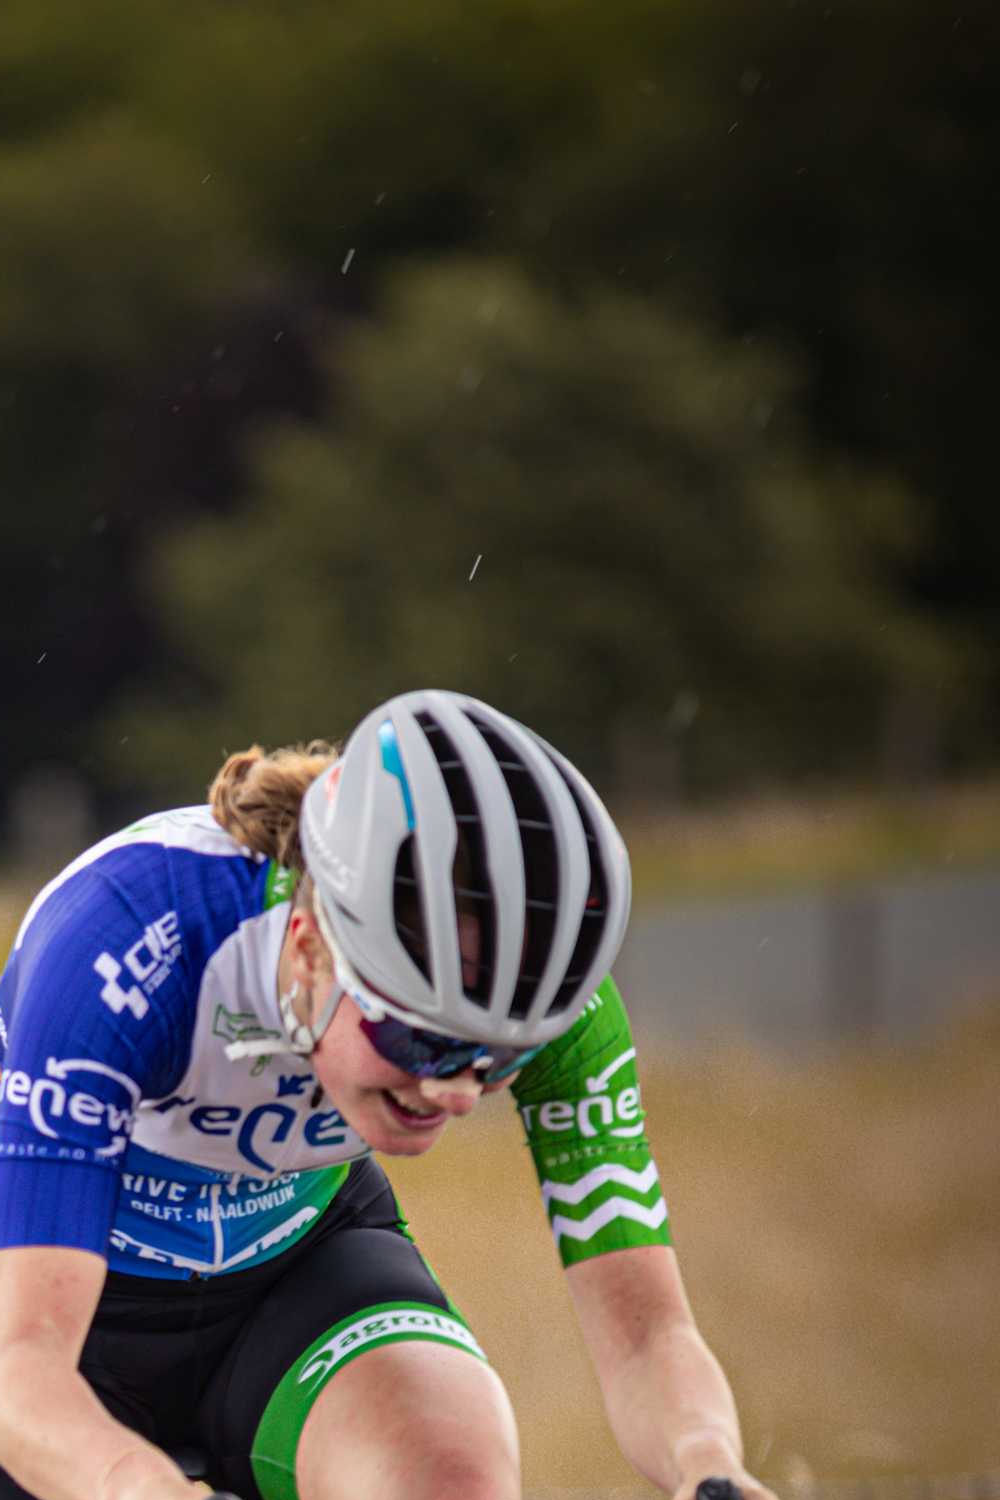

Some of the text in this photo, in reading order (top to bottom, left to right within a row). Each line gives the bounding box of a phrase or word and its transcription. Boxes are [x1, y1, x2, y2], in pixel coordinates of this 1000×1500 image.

[152, 1097, 350, 1173] rene
[522, 1084, 641, 1138] rene
[131, 1199, 183, 1222] DELFT
